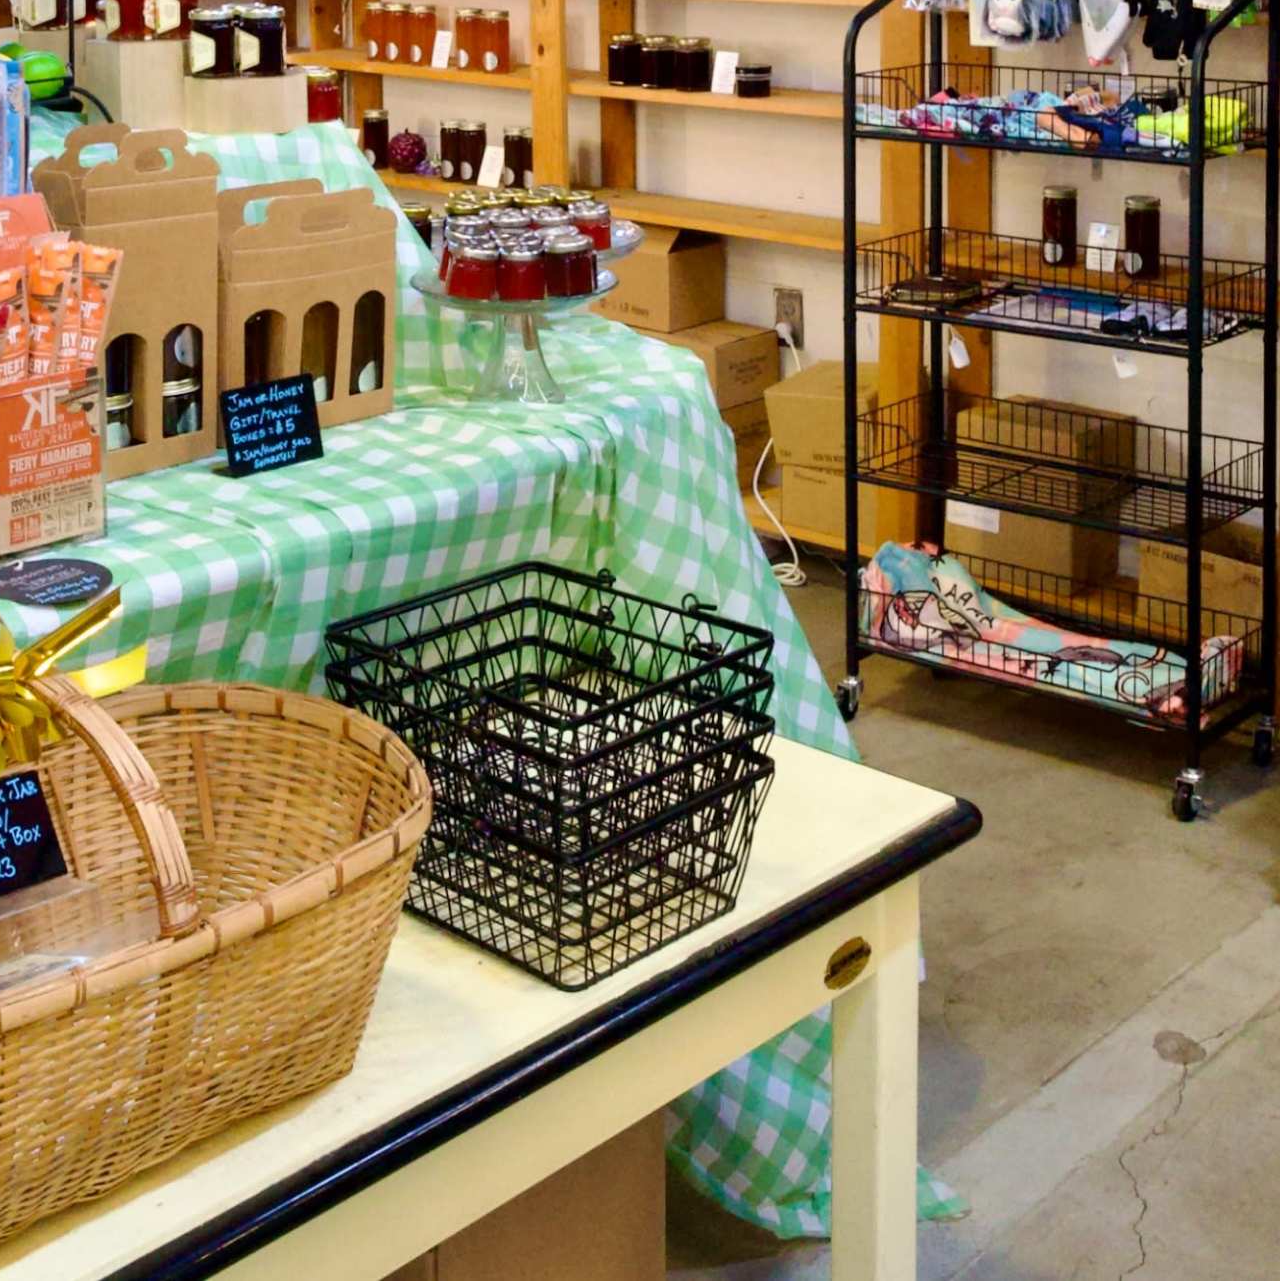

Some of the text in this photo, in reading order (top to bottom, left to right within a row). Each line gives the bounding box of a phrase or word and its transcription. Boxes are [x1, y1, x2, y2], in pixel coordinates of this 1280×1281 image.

[227, 393, 254, 412] JAM
[269, 383, 304, 401] HONEY
[21, 432, 71, 449] CRAFT JERKY
[232, 428, 266, 444] BOXES
[9, 442, 93, 472] FIERY HABANERO
[33, 491, 52, 503] BEEF
[9, 824, 42, 846] Box
